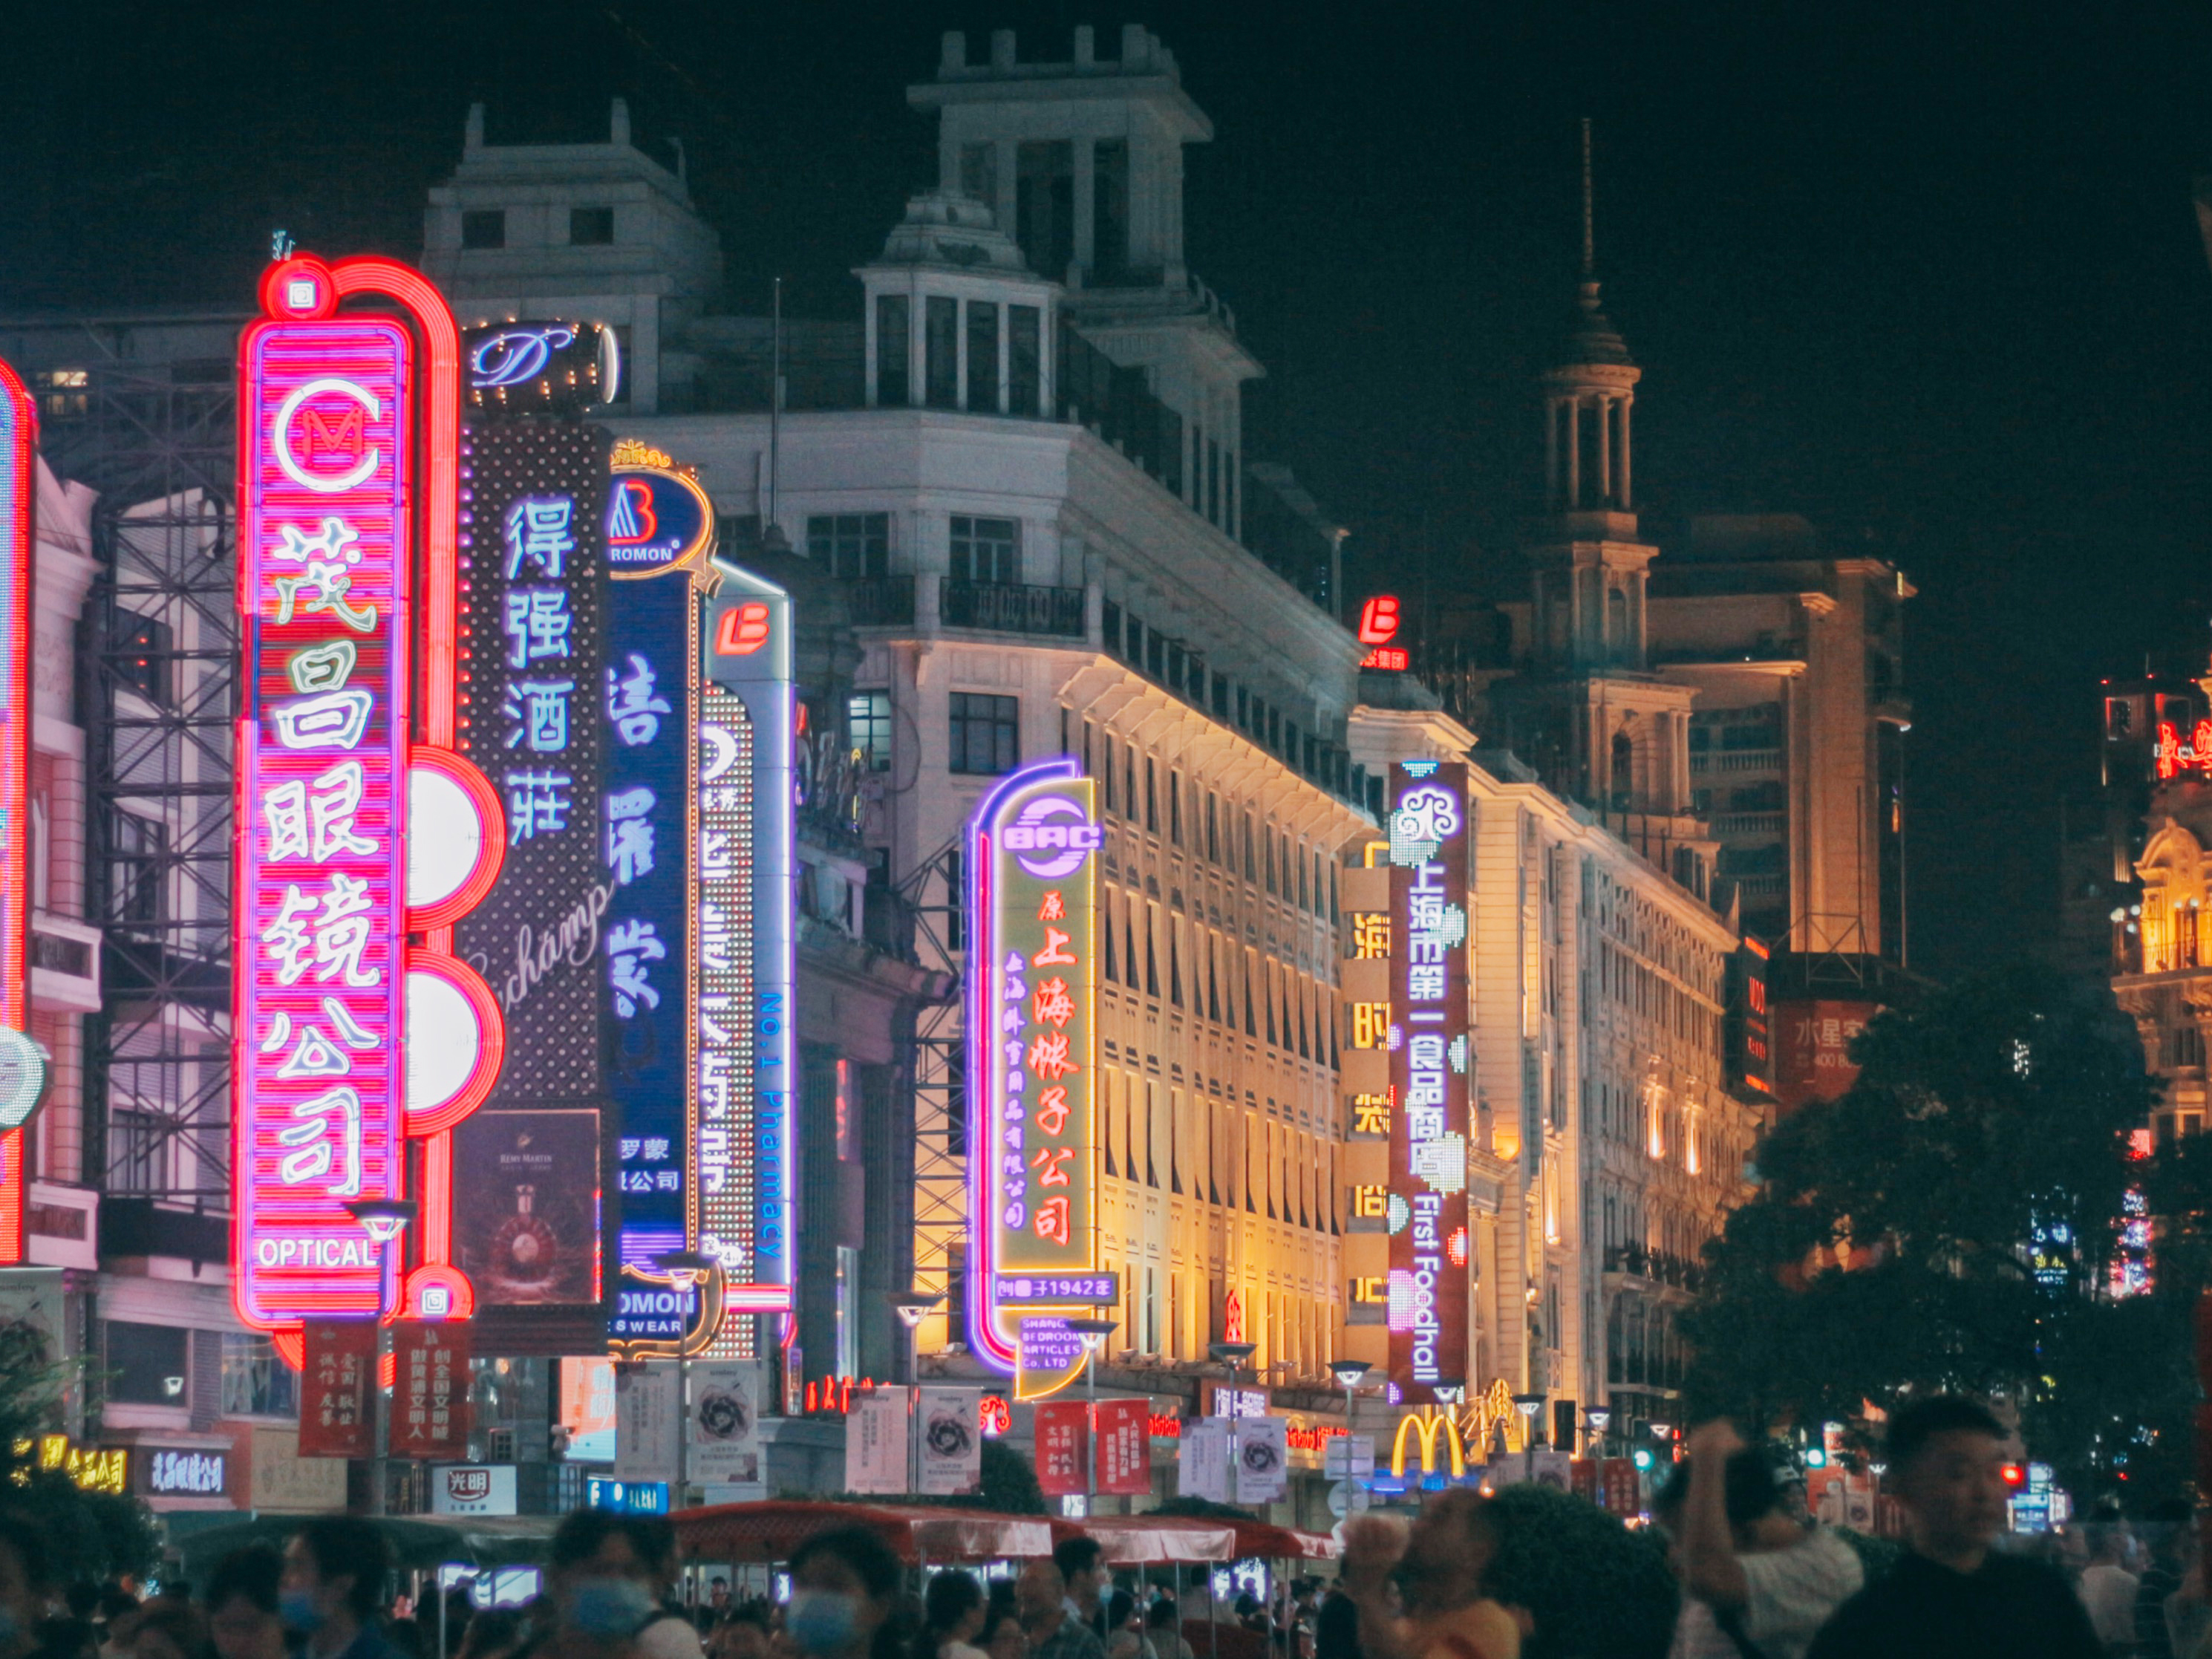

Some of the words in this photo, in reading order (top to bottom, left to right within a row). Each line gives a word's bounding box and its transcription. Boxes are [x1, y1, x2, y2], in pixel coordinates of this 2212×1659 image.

[611, 547, 673, 561] ROMON
[1002, 825, 1100, 850] BAC
[259, 516, 381, 1196] 茂昌眼镜公司
[1409, 860, 1446, 1176] 上海市第一食品商店
[756, 1092, 784, 1259] Pharmacy
[1413, 1196, 1440, 1251] First
[258, 1238, 379, 1267] OPTICAL
[630, 1320, 682, 1332] WEAR
[1413, 1257, 1440, 1381] Foodhall
[1022, 1344, 1082, 1355] ARTICLES
[1044, 1357, 1069, 1368] LTD
[450, 1472, 487, 1491] 光明
